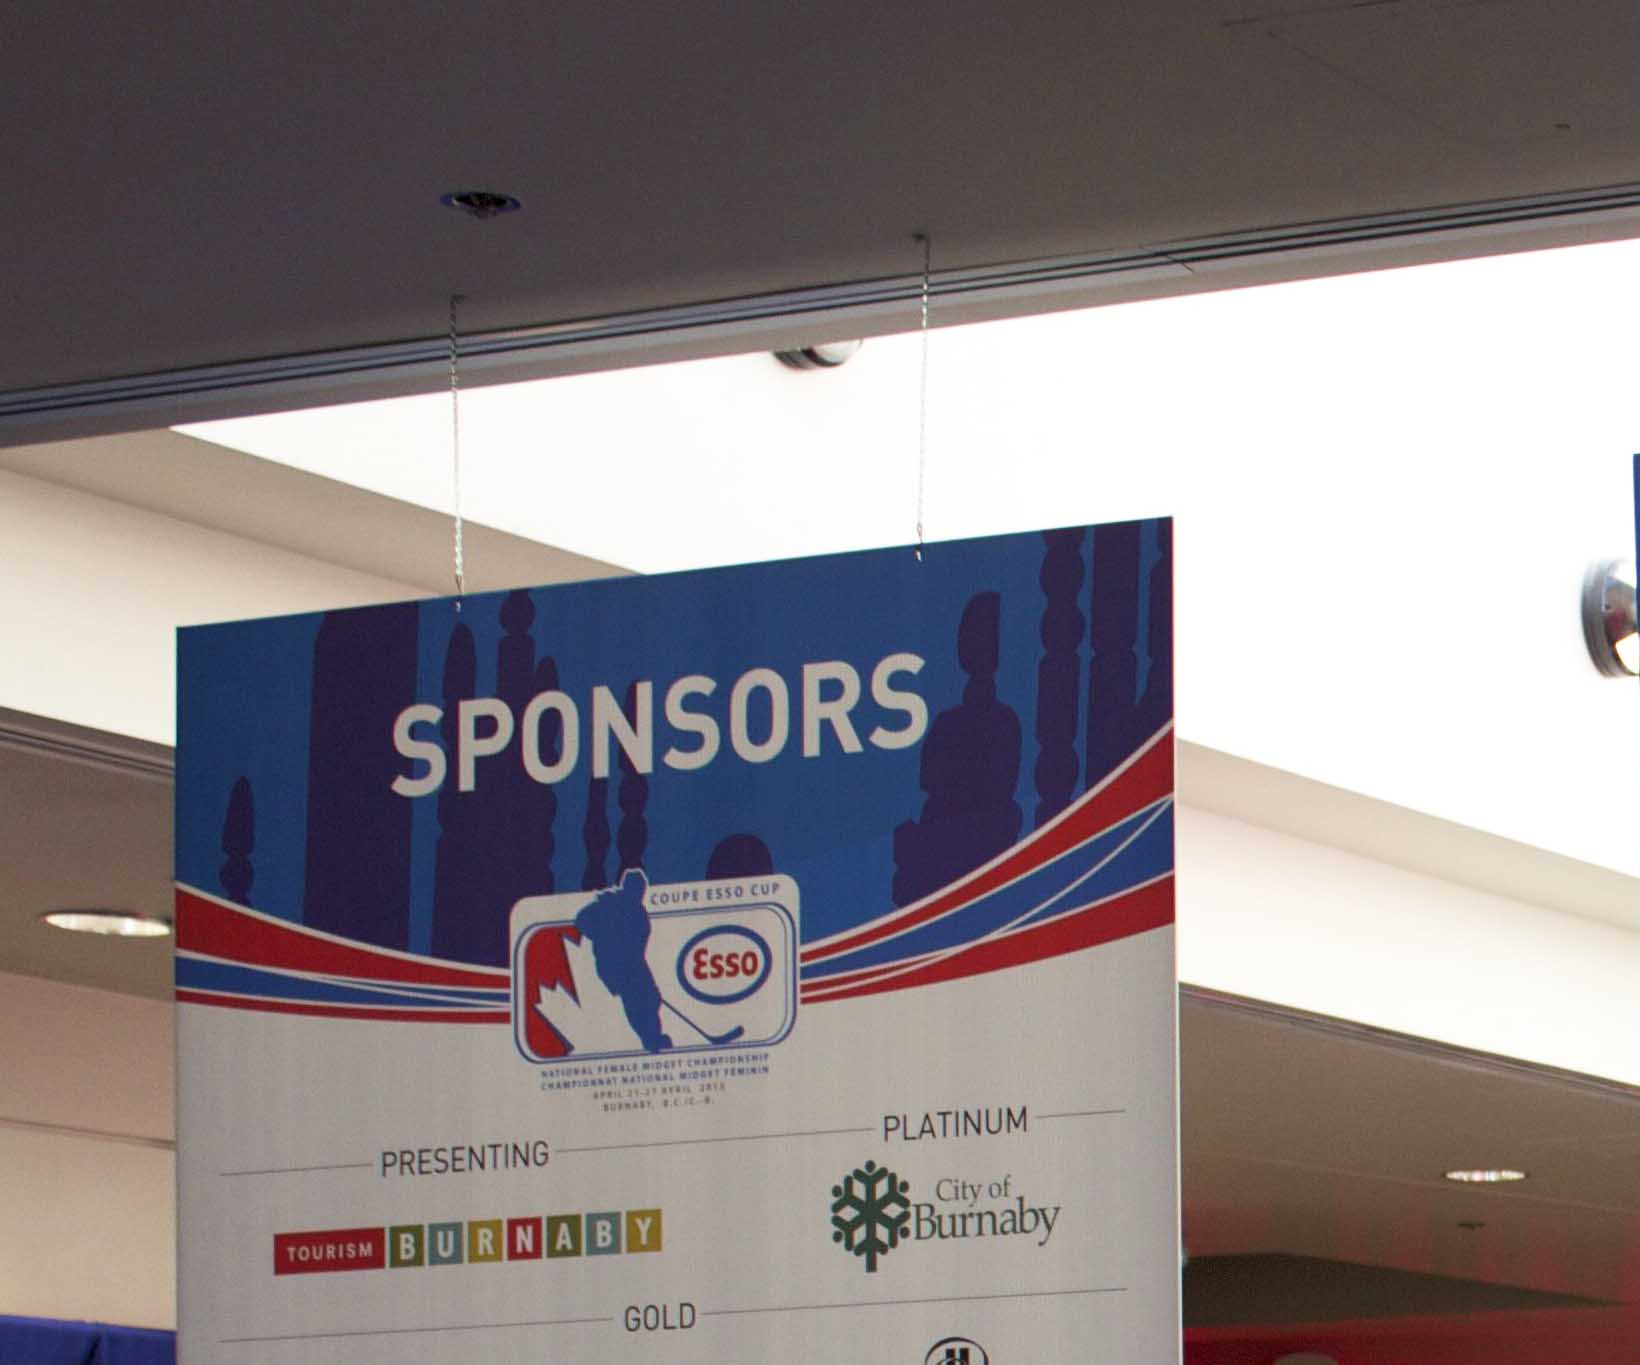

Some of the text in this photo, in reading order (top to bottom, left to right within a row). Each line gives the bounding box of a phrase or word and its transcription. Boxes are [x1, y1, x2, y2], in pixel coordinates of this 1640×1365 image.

[392, 653, 928, 796] SPONSORS
[884, 1106, 1027, 1141] PLATINUM
[382, 1141, 548, 1177] PRESENTING
[936, 1175, 1010, 1207] City of
[287, 1218, 654, 1262] TOURISM BURNABY
[913, 1200, 1061, 1246] Burnaby
[625, 1302, 695, 1332] GOLD
